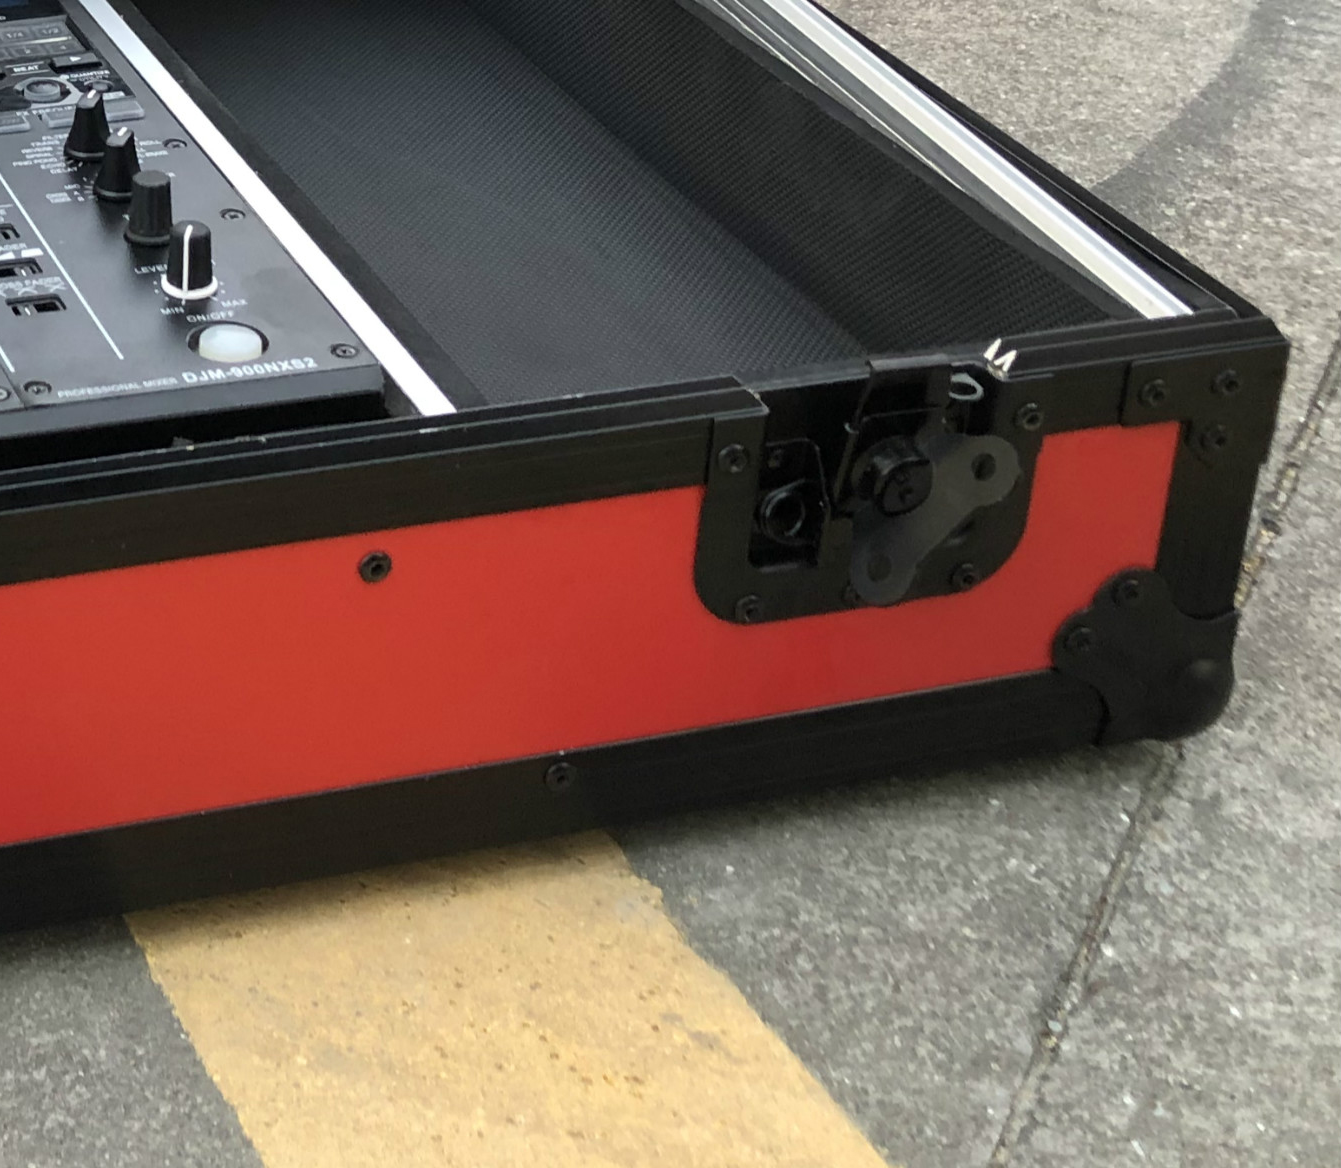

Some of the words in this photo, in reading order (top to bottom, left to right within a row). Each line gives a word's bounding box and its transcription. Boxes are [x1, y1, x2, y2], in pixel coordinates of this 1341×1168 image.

[13, 64, 40, 73] BEAT
[30, 139, 60, 147] TRANS
[50, 167, 78, 175] DELAY
[25, 276, 62, 286] FADER
[160, 307, 185, 316] MIN
[220, 299, 248, 309] MAX
[186, 310, 235, 323] ON/OFF
[57, 381, 141, 399] PROFESSIONAL
[142, 376, 179, 389] MIXER
[181, 357, 318, 384] DJM-900NXS2
